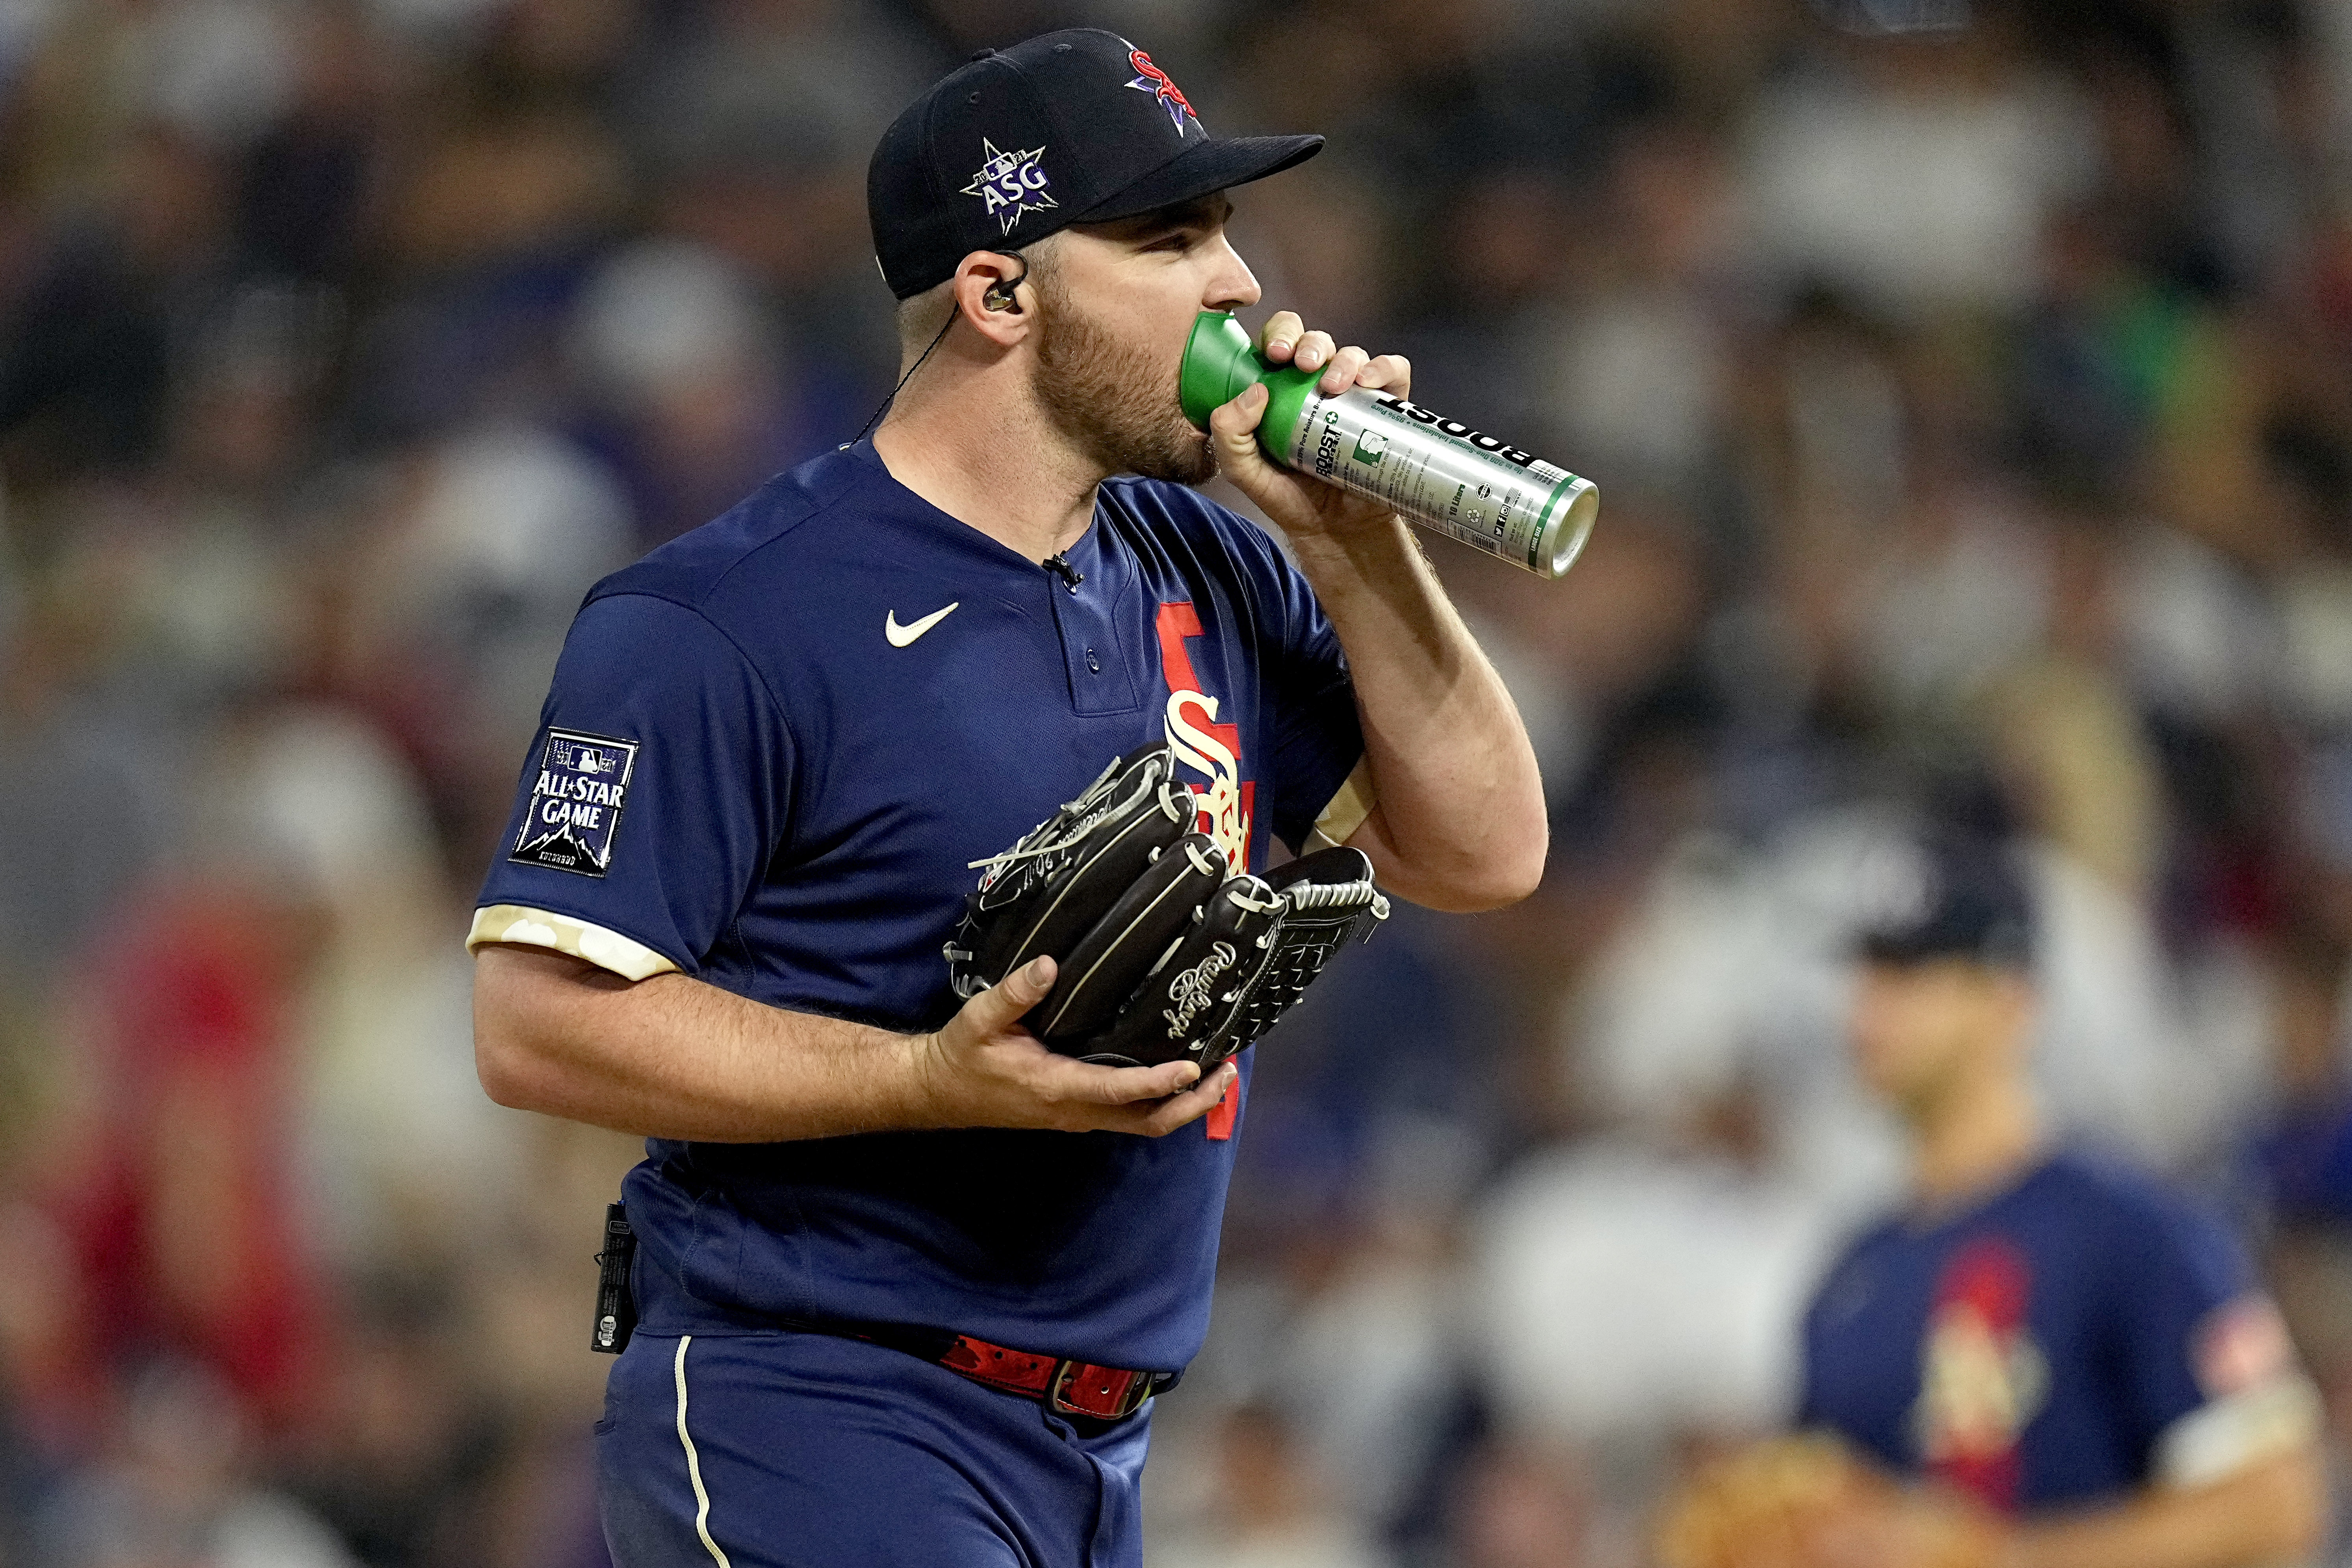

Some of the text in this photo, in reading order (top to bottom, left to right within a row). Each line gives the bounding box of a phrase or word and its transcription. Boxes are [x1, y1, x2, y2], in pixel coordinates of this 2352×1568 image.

[981, 162, 1047, 215] ASG
[1370, 404, 1387, 416] Pure
[1387, 411, 1405, 423] 95%
[1298, 433, 1308, 446] Pure
[1303, 410, 1317, 433] Aviators
[1375, 398, 1539, 468] BOOST
[1411, 421, 1449, 442] Inhalations
[1314, 424, 1338, 477] BOOST
[1448, 438, 1489, 460] One-Second
[1489, 456, 1504, 466] 200
[1448, 483, 1466, 516] 10 Liters
[1530, 525, 1542, 551] LARGE SIZE
[542, 800, 602, 829] GAME
[1163, 941, 1236, 1040] Rawlings
